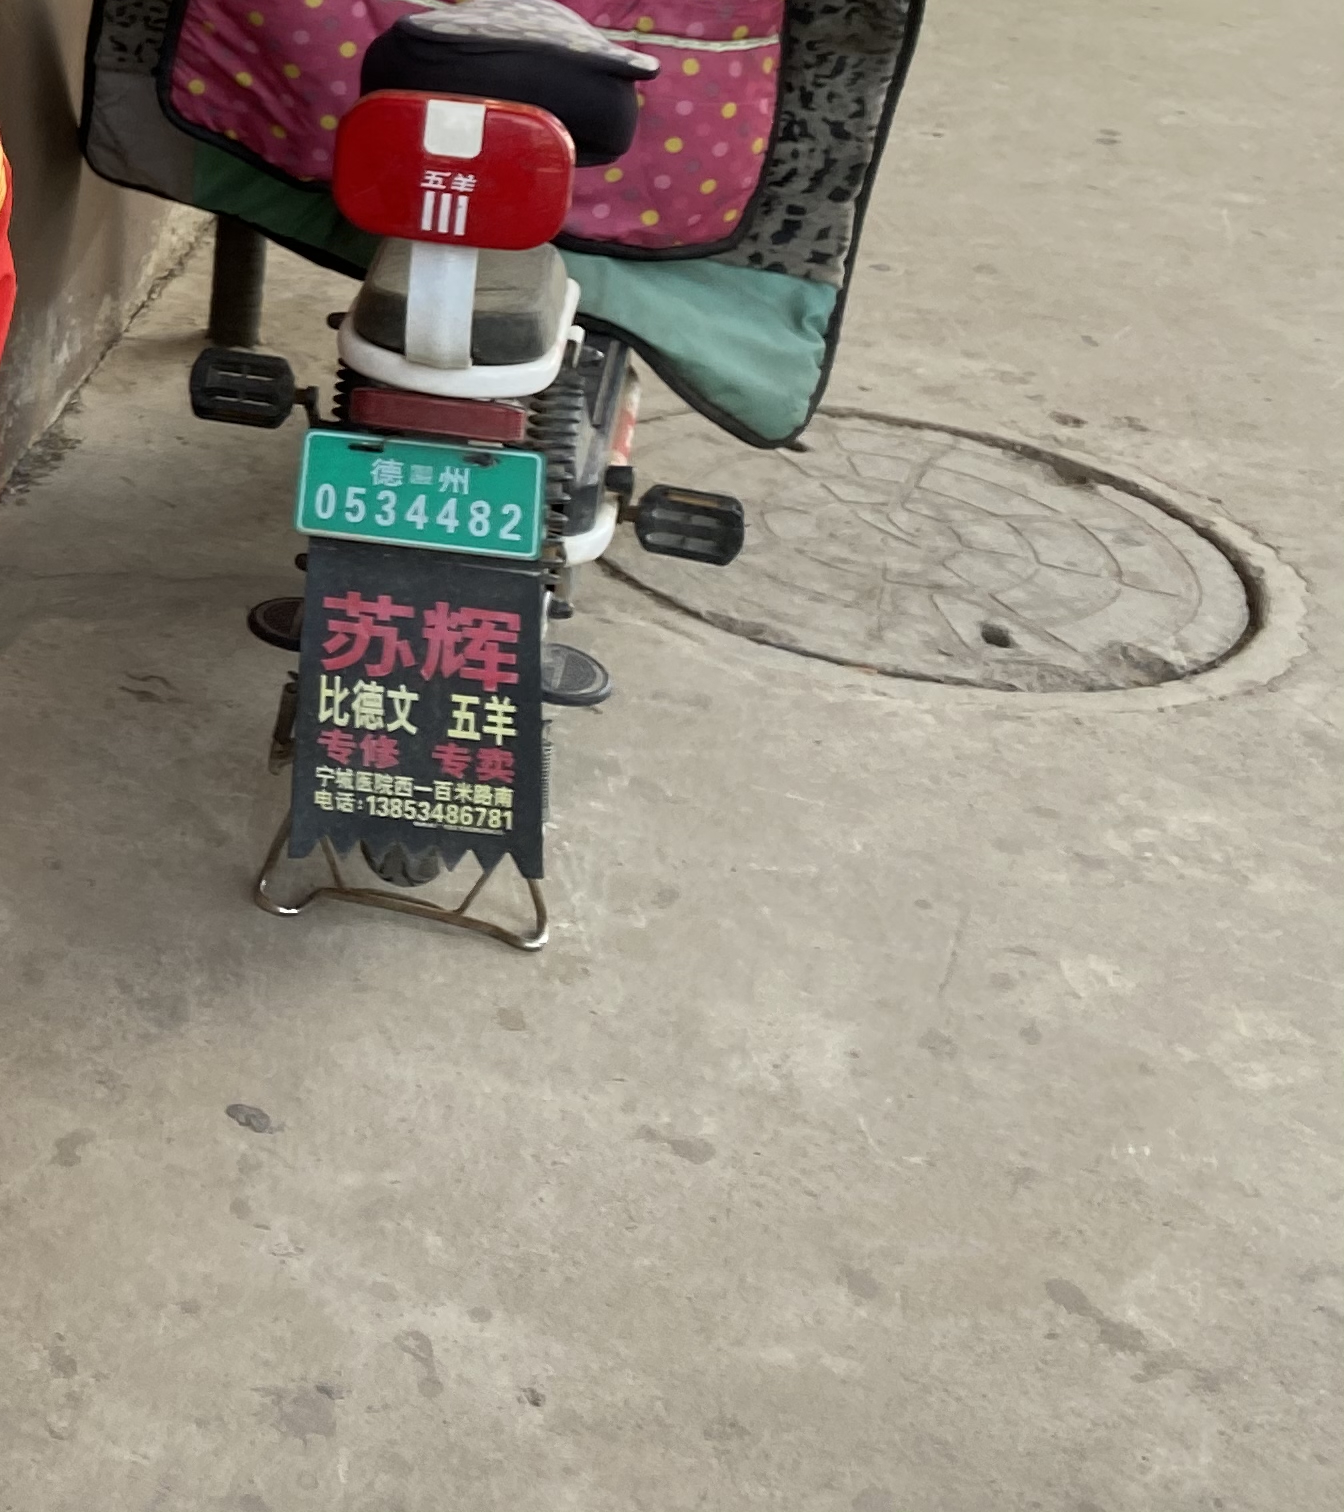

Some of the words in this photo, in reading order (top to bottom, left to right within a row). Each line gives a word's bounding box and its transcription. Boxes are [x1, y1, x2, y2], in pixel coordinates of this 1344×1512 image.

[421, 170, 478, 193] 五羊
[315, 483, 523, 541] 0534482
[320, 591, 522, 692] 苏辉
[317, 674, 420, 735] 比德文
[447, 693, 518, 747] 五羊
